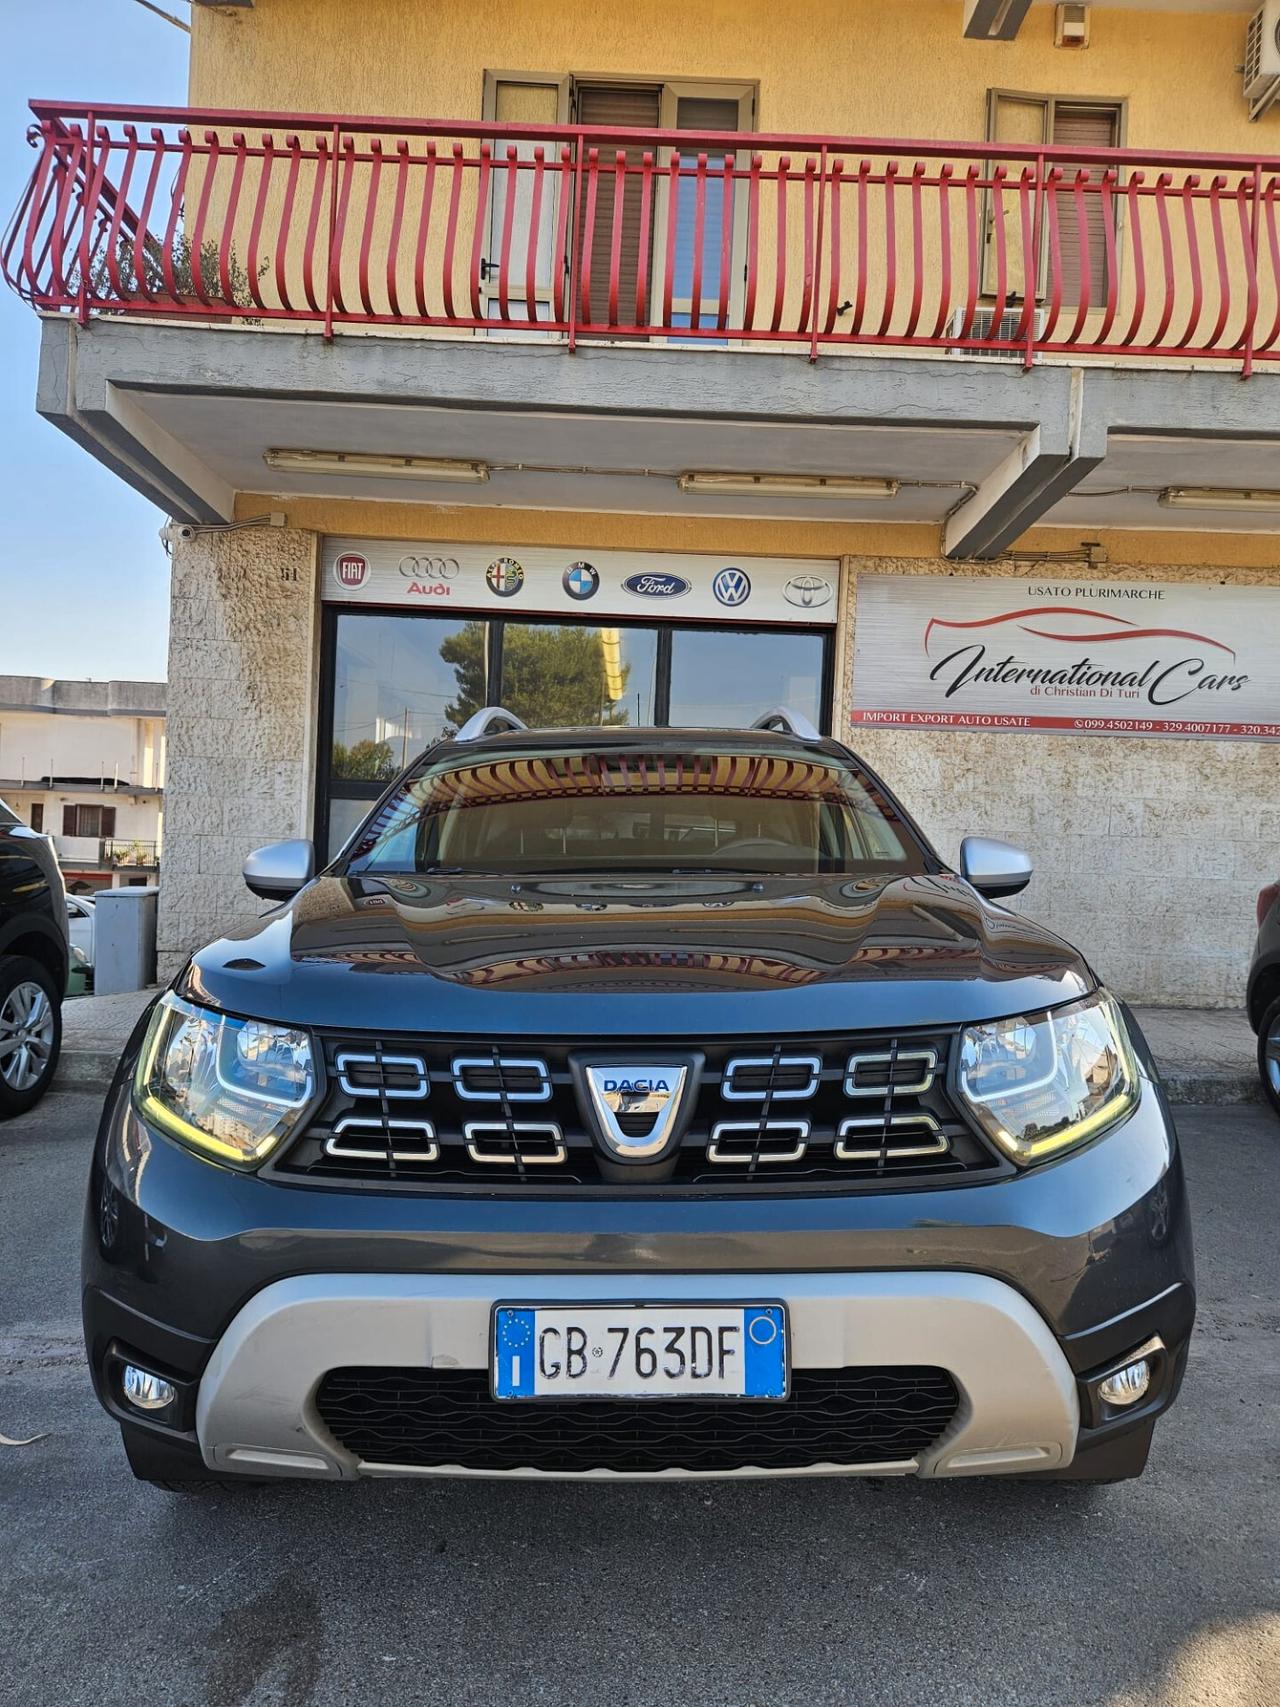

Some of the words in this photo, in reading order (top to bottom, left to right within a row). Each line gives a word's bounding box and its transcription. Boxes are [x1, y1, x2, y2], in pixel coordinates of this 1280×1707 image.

[342, 562, 363, 579] FIAT
[407, 582, 450, 595] Audi
[637, 576, 675, 594] Ford
[1028, 586, 1071, 597] USATO
[1075, 587, 1165, 600] PLURIMARCHE
[930, 645, 1159, 698] International
[1148, 658, 1250, 705] Cars
[1030, 685, 1040, 696] di
[1045, 686, 1095, 697] Christian
[1100, 687, 1113, 698] Di
[1116, 688, 1140, 698] Turi
[863, 711, 907, 722] IMPORT
[910, 713, 954, 724] EXPORT
[959, 714, 991, 725] AUTO
[995, 715, 1031, 726] USATE
[1084, 719, 1153, 731] 099.4502149
[1163, 722, 1230, 733] 329.4007177
[604, 1080, 669, 1091] DACIA
